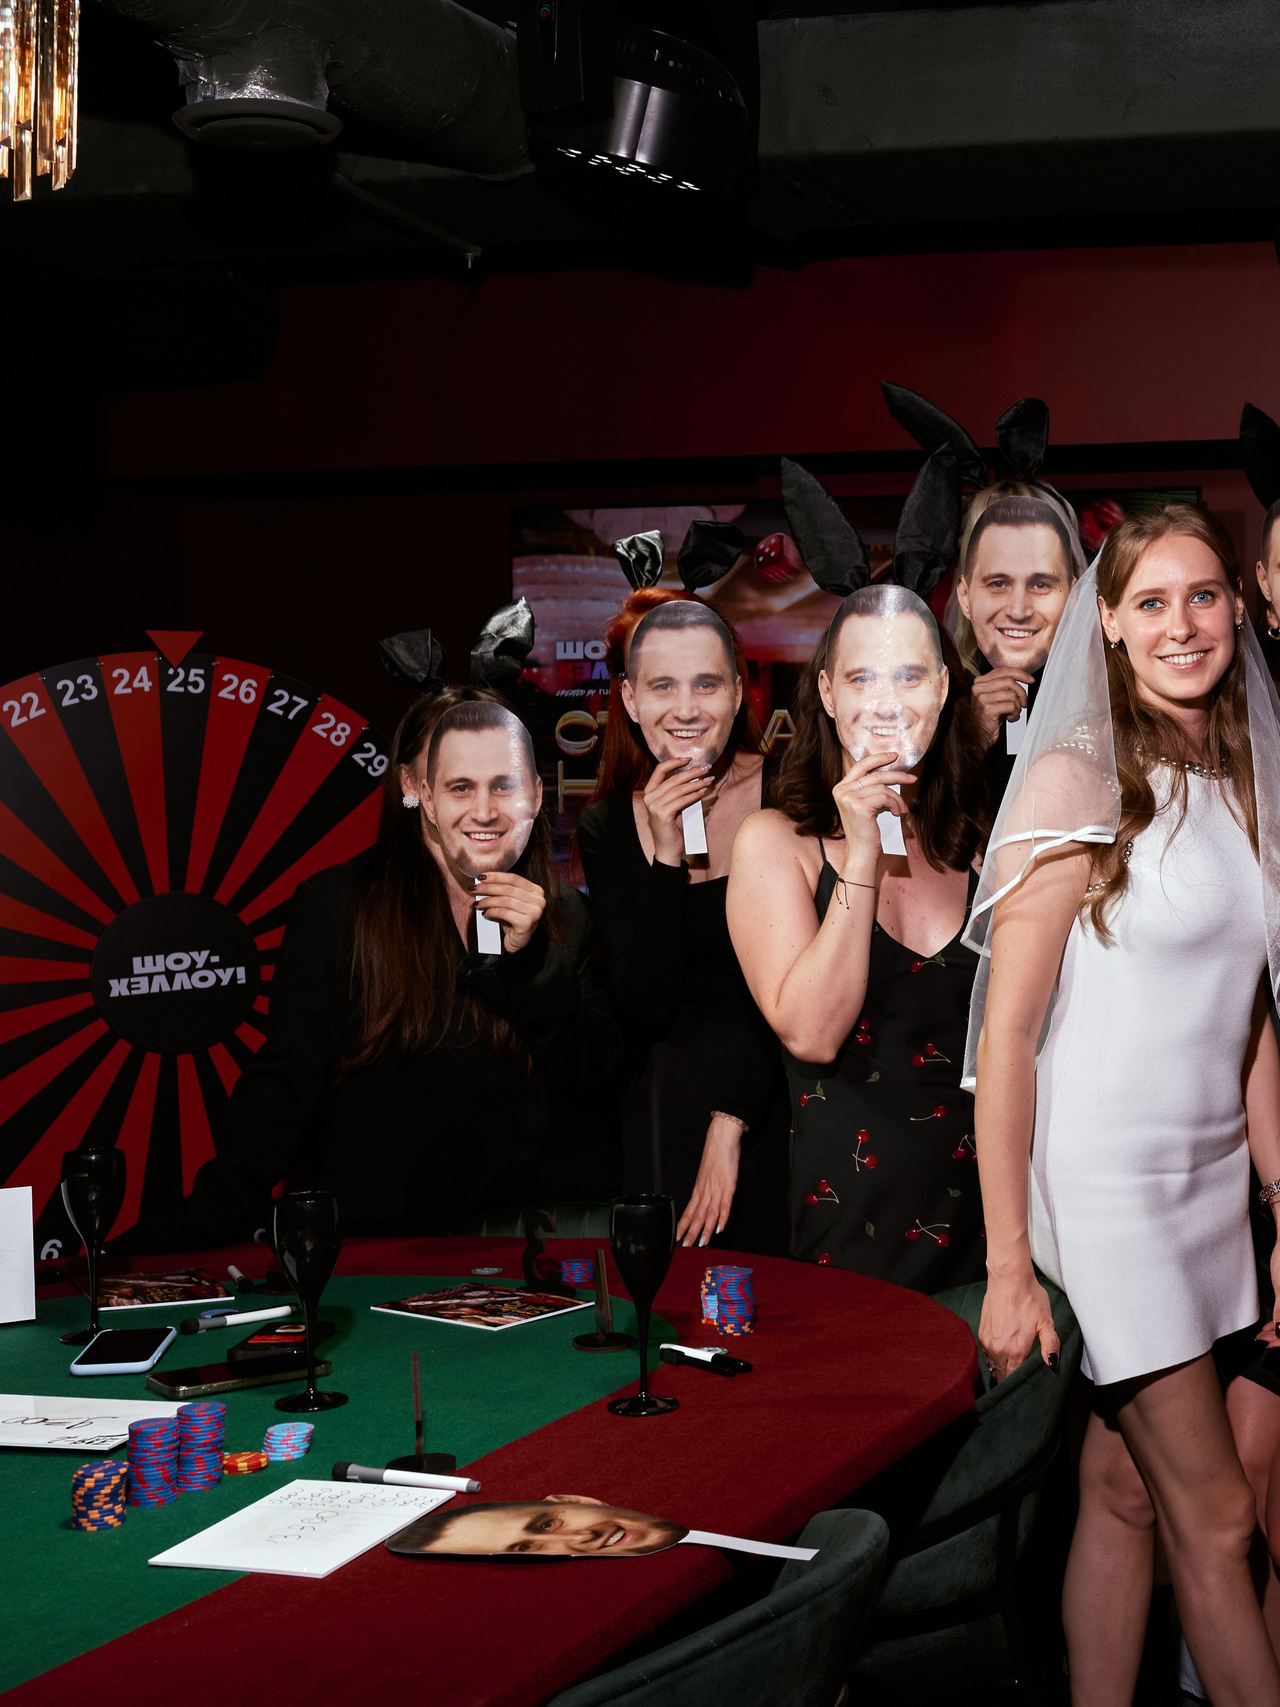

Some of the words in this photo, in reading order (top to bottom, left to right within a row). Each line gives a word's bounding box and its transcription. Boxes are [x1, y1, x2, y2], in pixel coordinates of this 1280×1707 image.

[556, 640, 610, 659] ШО
[2, 692, 46, 728] 22
[56, 674, 98, 707] 23
[112, 666, 153, 695] 24
[166, 667, 205, 694] 25
[218, 673, 258, 704] 26
[266, 689, 309, 720] 27
[311, 712, 351, 746] 28
[352, 742, 389, 777] 29
[132, 950, 220, 975] ШОУ-
[108, 966, 246, 997] ХЭЛЛОУ!
